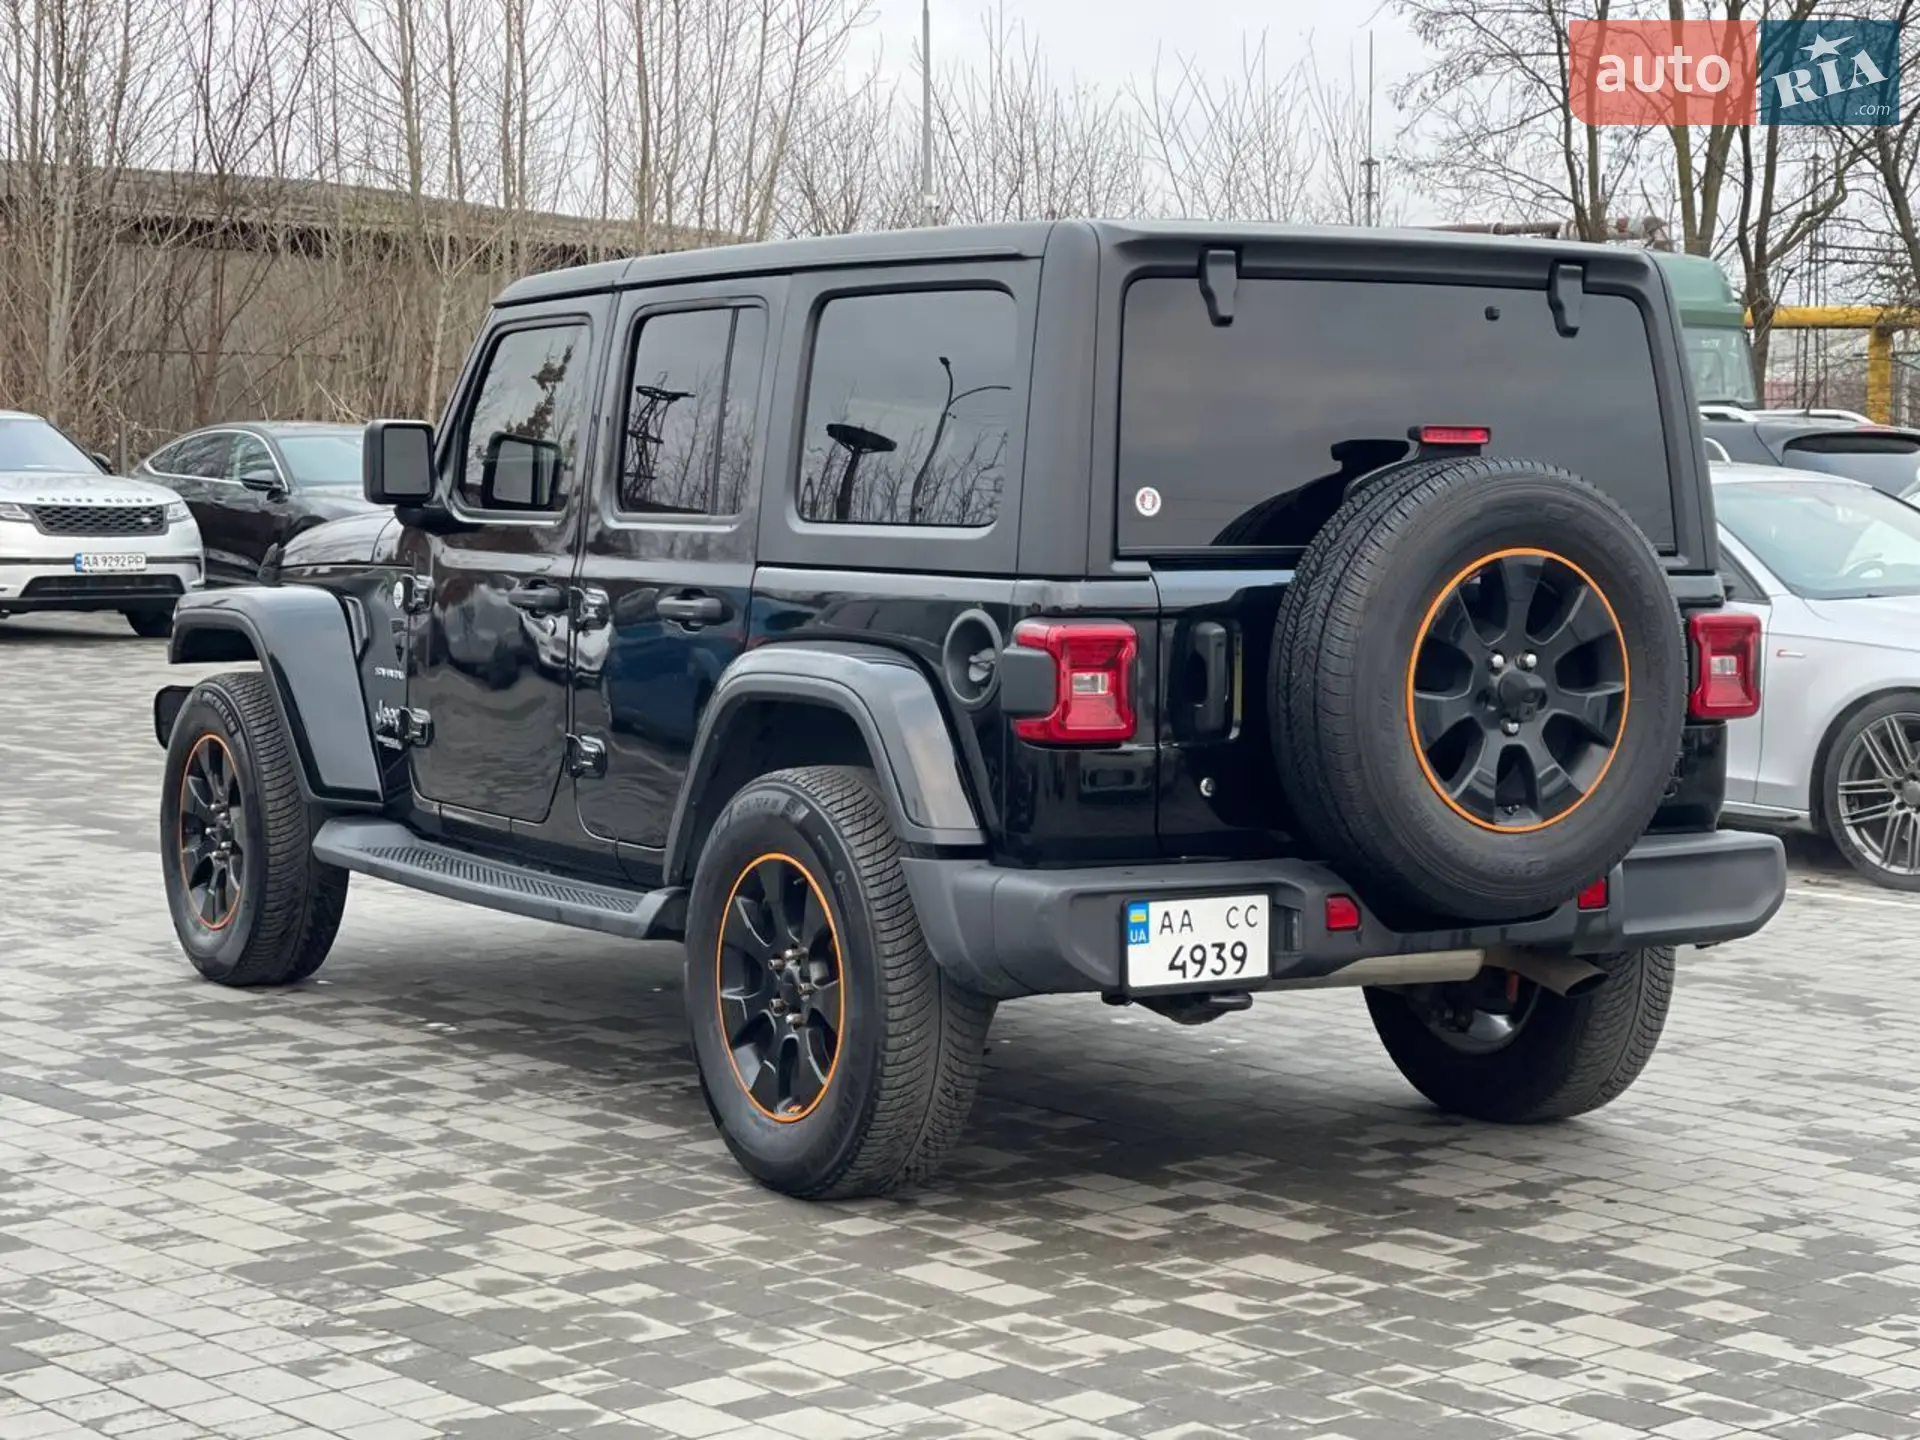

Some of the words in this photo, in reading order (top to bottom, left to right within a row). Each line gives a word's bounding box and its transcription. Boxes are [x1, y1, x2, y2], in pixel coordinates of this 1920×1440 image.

[83, 556, 99, 567] AA
[102, 556, 126, 567] 9292
[1159, 909, 1194, 935] AA
[1226, 904, 1258, 930] CC
[1130, 930, 1148, 943] UA
[1168, 941, 1248, 979] 4939
